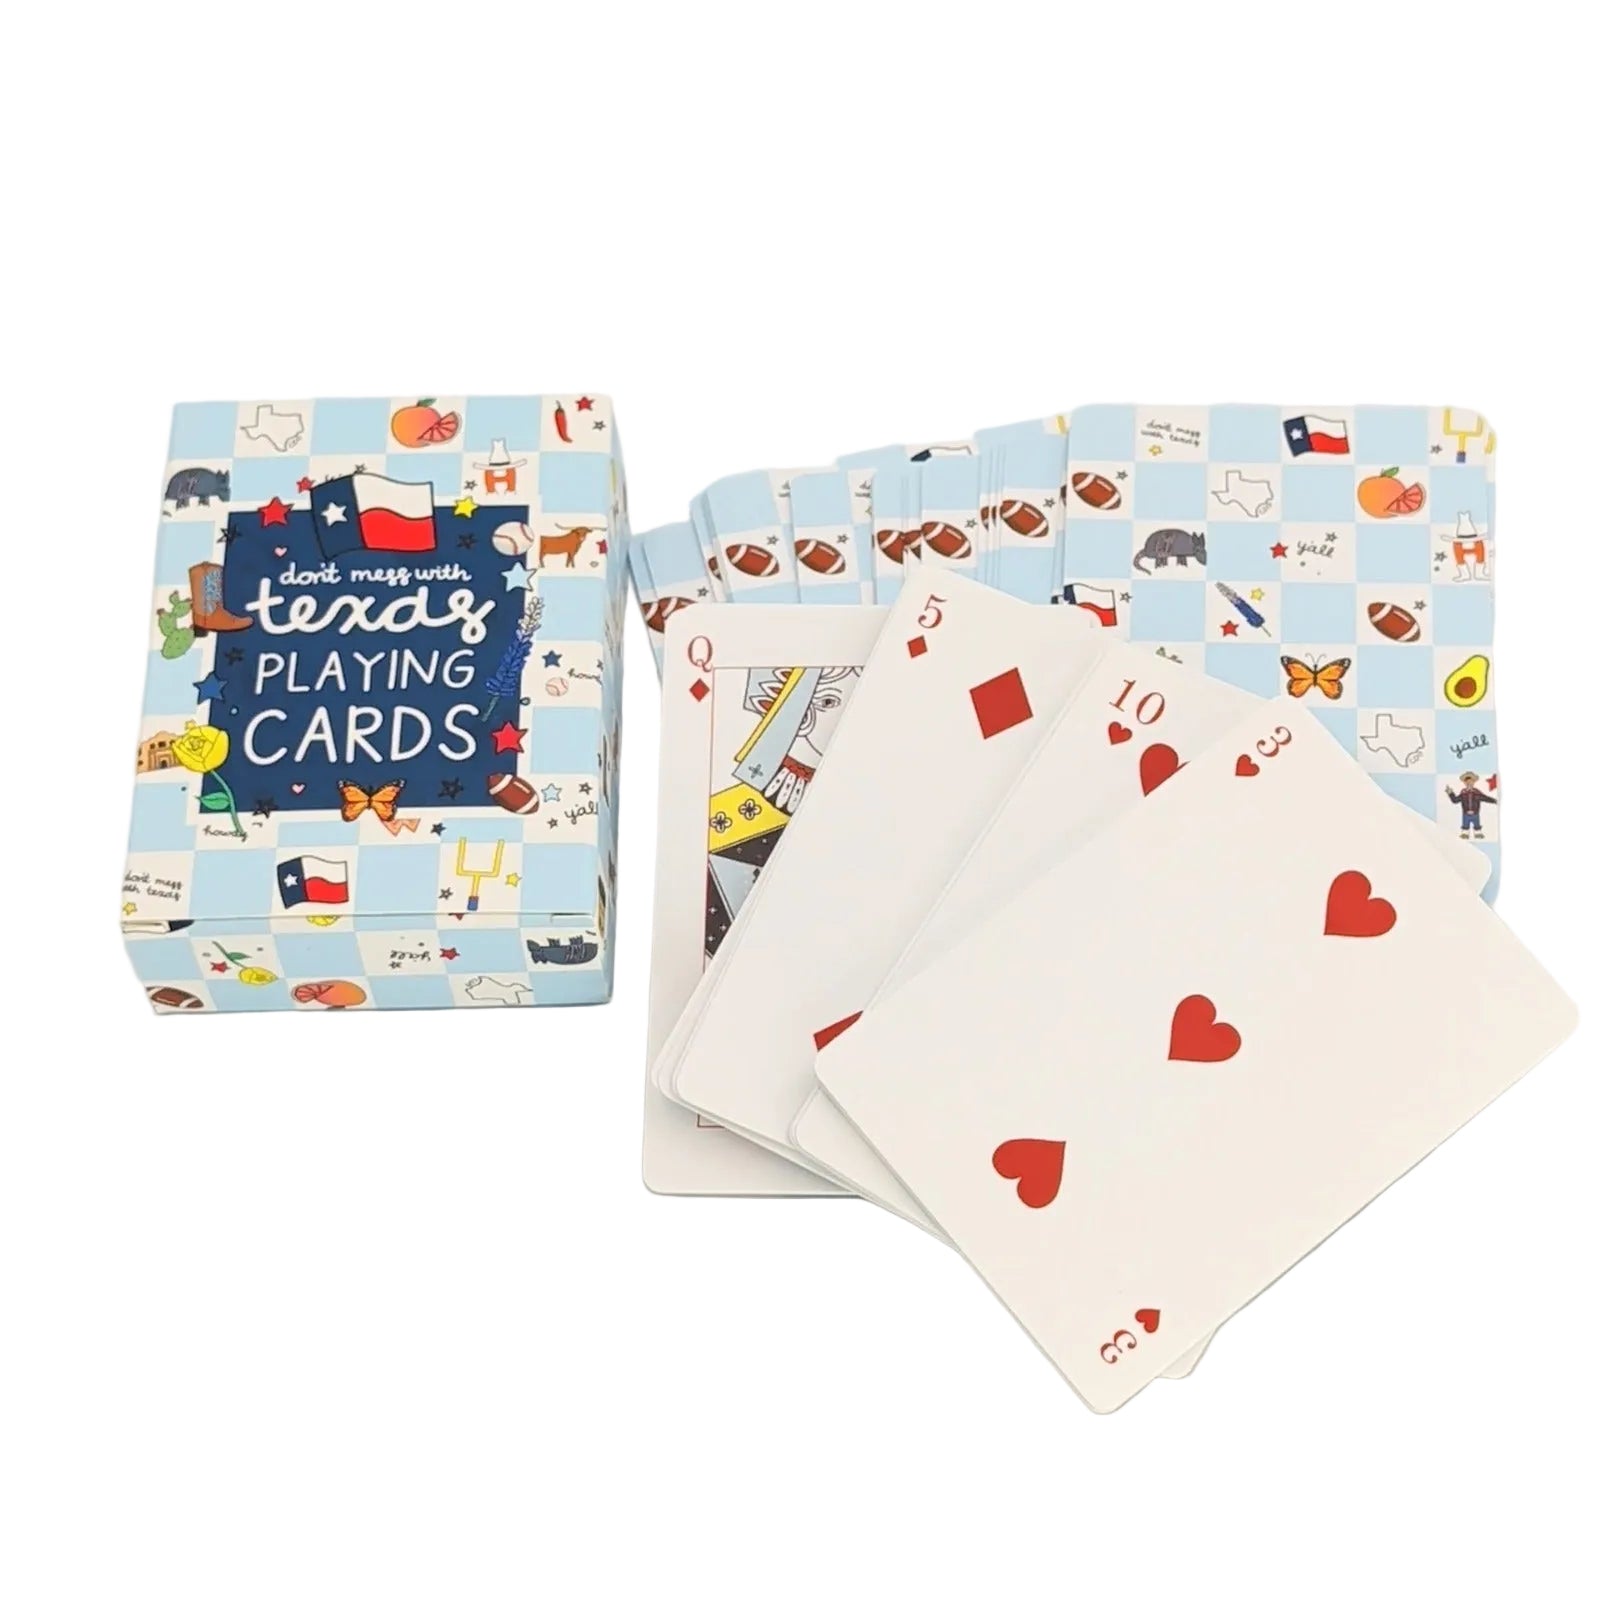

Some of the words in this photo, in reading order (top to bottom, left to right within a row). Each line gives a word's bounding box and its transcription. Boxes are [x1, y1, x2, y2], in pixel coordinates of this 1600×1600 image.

[350, 565, 412, 587] mess
[415, 563, 472, 582] with
[245, 577, 497, 645] texas
[918, 594, 948, 629] 5
[255, 649, 475, 695] PLAYING
[688, 635, 713, 673] Q
[1109, 679, 1165, 725] 10
[244, 704, 480, 765] CARDS
[1256, 726, 1292, 757] 3
[1101, 1329, 1137, 1365] 3
